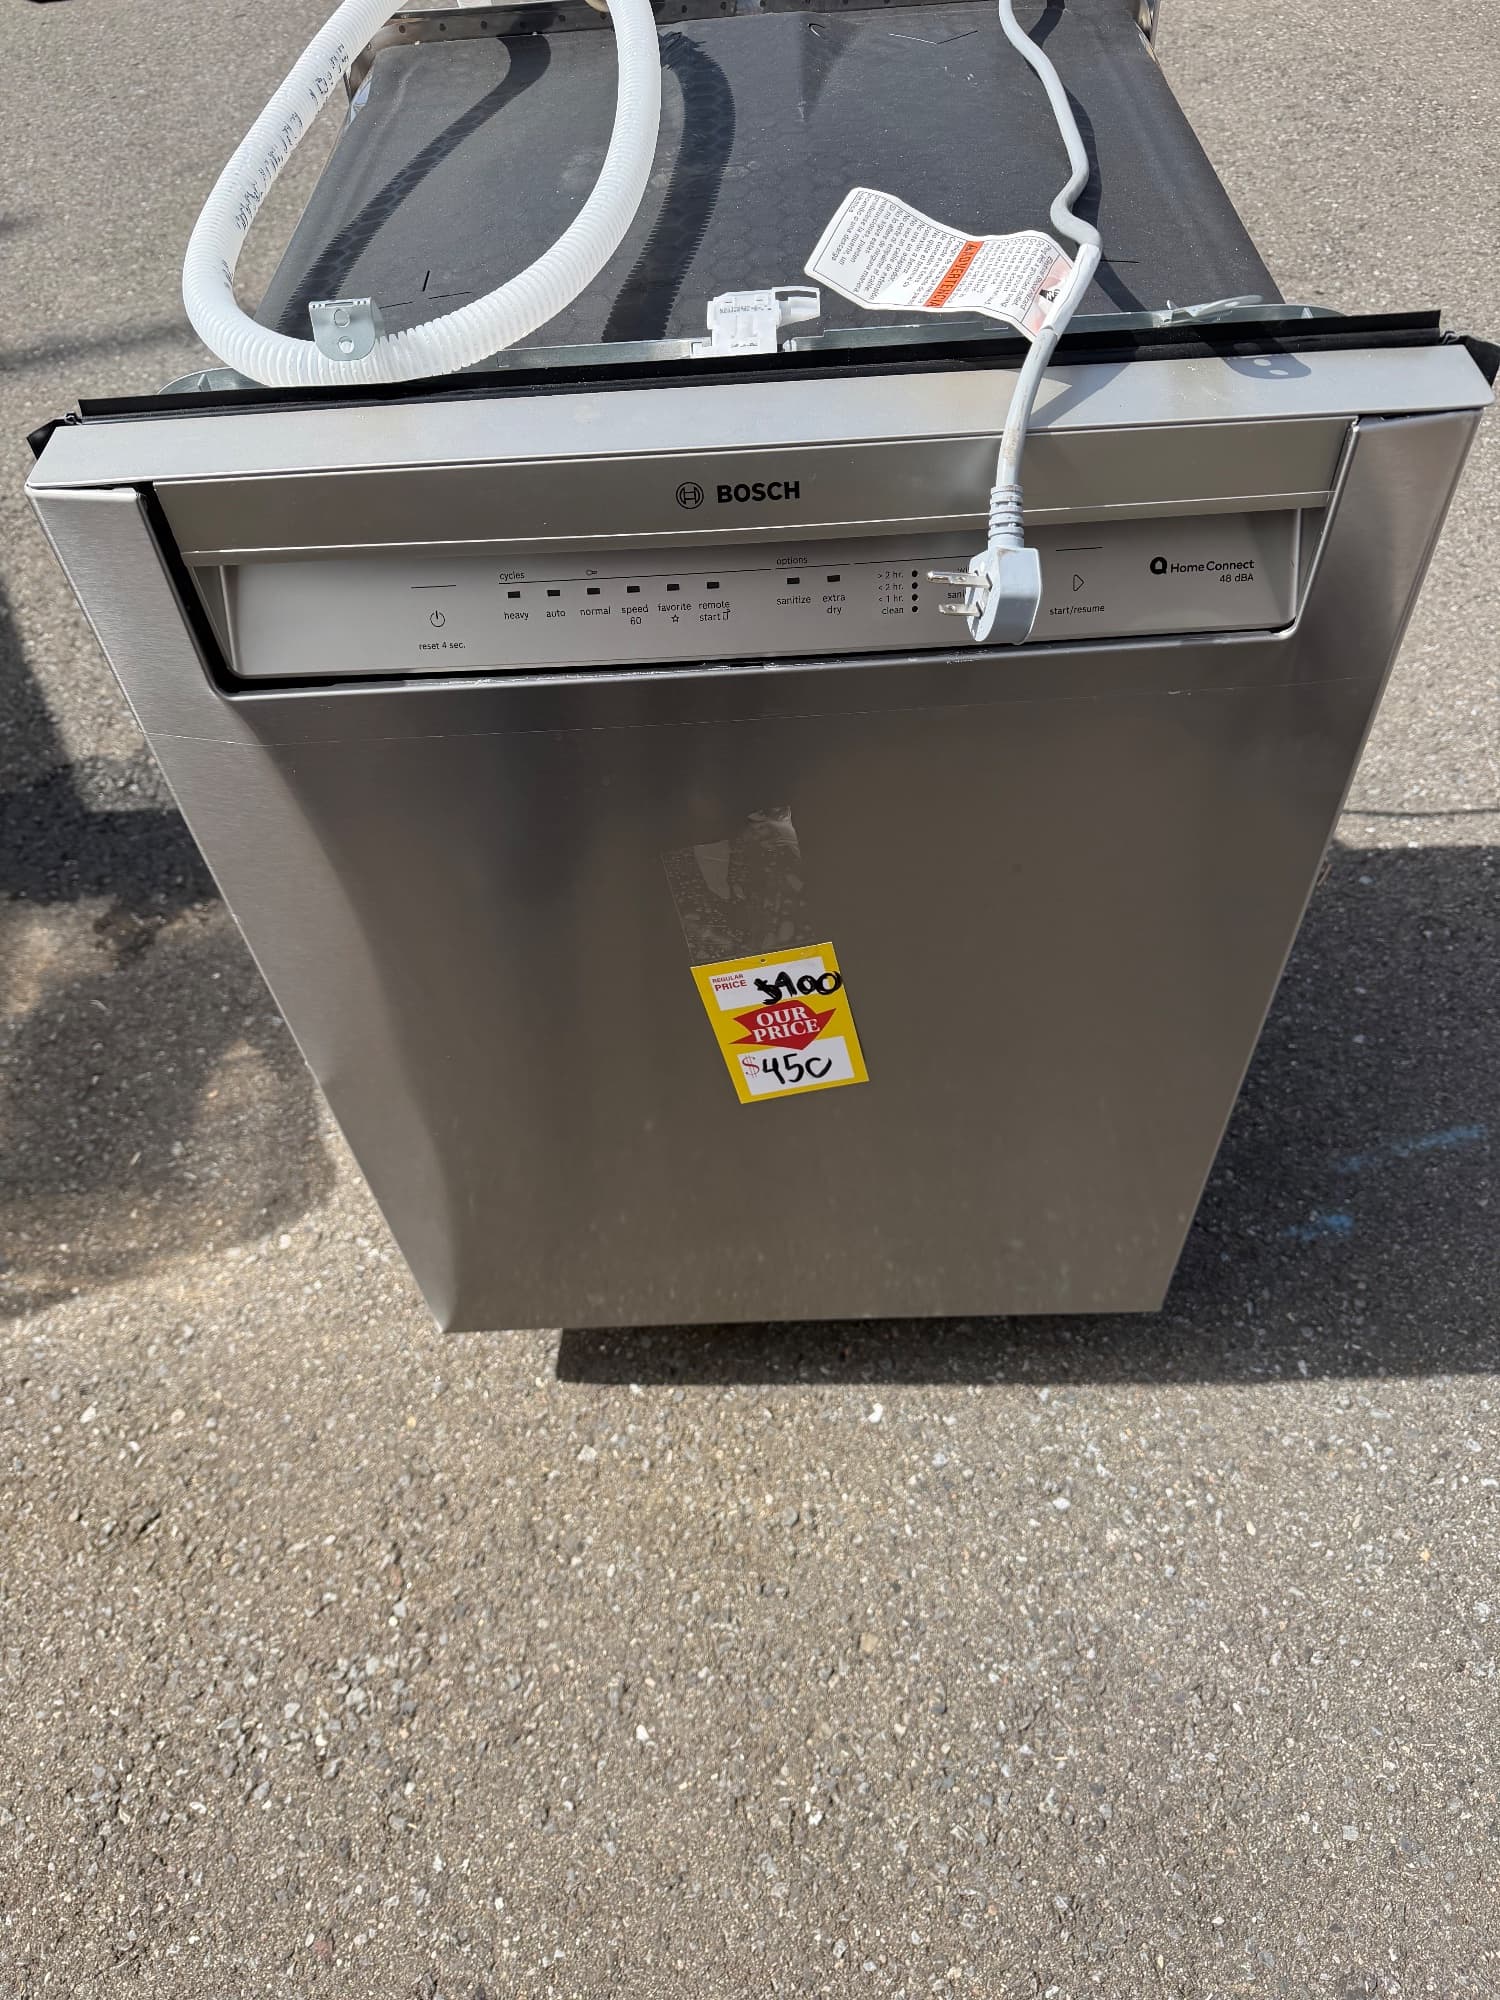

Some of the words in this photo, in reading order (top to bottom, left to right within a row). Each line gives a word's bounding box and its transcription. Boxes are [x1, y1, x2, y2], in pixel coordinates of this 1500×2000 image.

[926, 251, 974, 307] ADVERTENCIA
[717, 481, 800, 503] BOSCH
[776, 555, 808, 566] options
[1171, 563, 1204, 573] Home
[1206, 560, 1254, 571] Connect
[498, 568, 525, 582] cycles
[893, 570, 904, 579] hr.
[1219, 573, 1232, 583] 48
[1234, 572, 1254, 582] dBA
[776, 595, 812, 606] sanitize
[822, 594, 846, 603] extra
[893, 594, 904, 602] hr.
[579, 605, 611, 616] normal
[621, 603, 649, 616] speed
[657, 603, 692, 612] favorite
[698, 600, 731, 611] remote
[826, 605, 842, 616] dry
[881, 606, 904, 615] clean
[1049, 605, 1105, 616] start/resume
[503, 611, 529, 621] heavy
[546, 609, 566, 618] auto
[699, 613, 721, 622] start
[630, 616, 642, 625] 60
[418, 642, 440, 650] reset
[441, 641, 447, 649] 4
[712, 974, 744, 983] REGULAR
[714, 980, 747, 992] PRICE
[756, 1006, 809, 1027] OUR
[752, 1019, 820, 1043] PRICE
